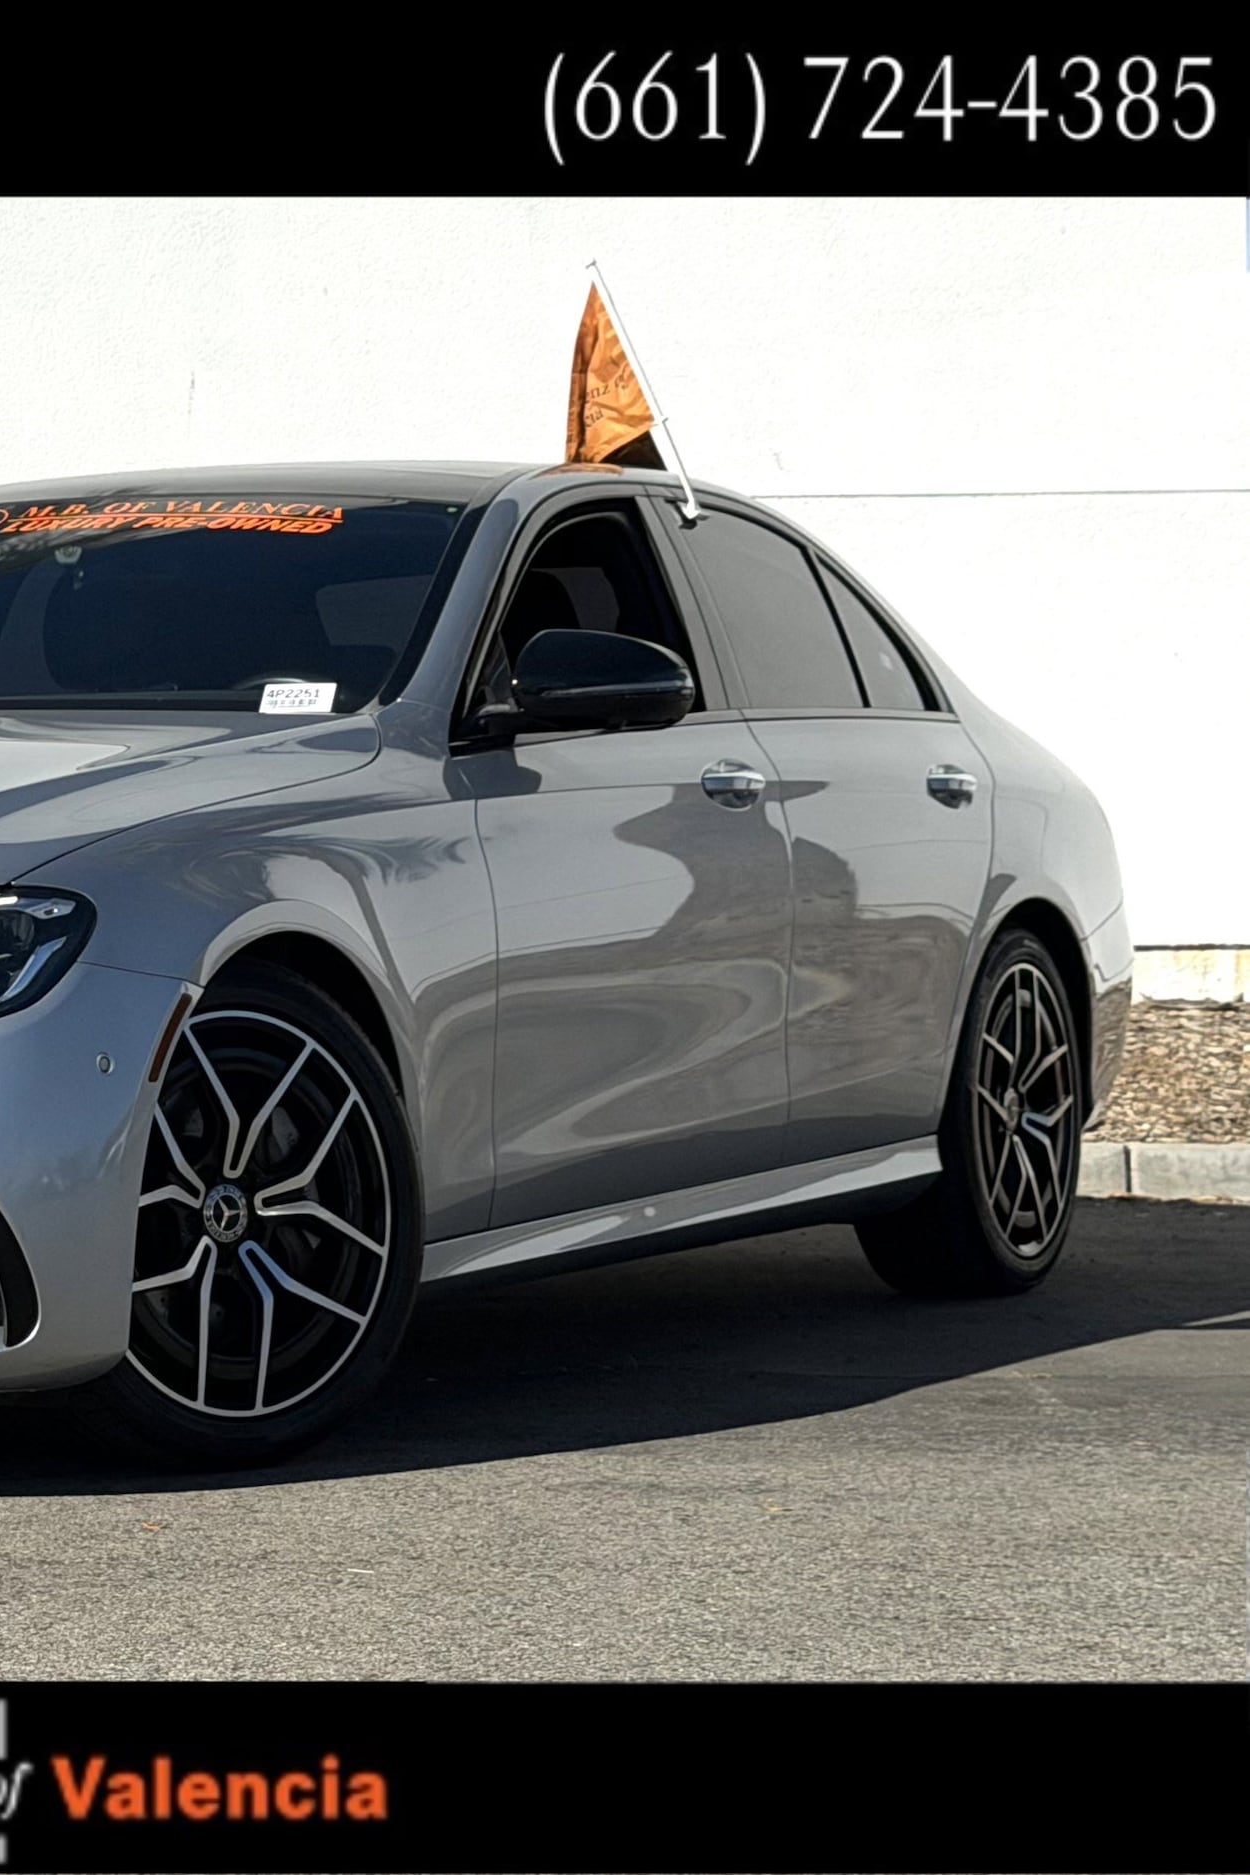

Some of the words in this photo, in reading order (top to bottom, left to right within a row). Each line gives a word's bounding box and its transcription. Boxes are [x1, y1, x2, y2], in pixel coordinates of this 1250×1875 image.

[20, 504, 89, 517] M.B.
[104, 501, 156, 513] OF
[167, 501, 343, 519] VALENCIA
[0, 517, 136, 533] LUXURY
[132, 517, 333, 534] PRE-OWNED
[266, 688, 320, 699] 4P2251
